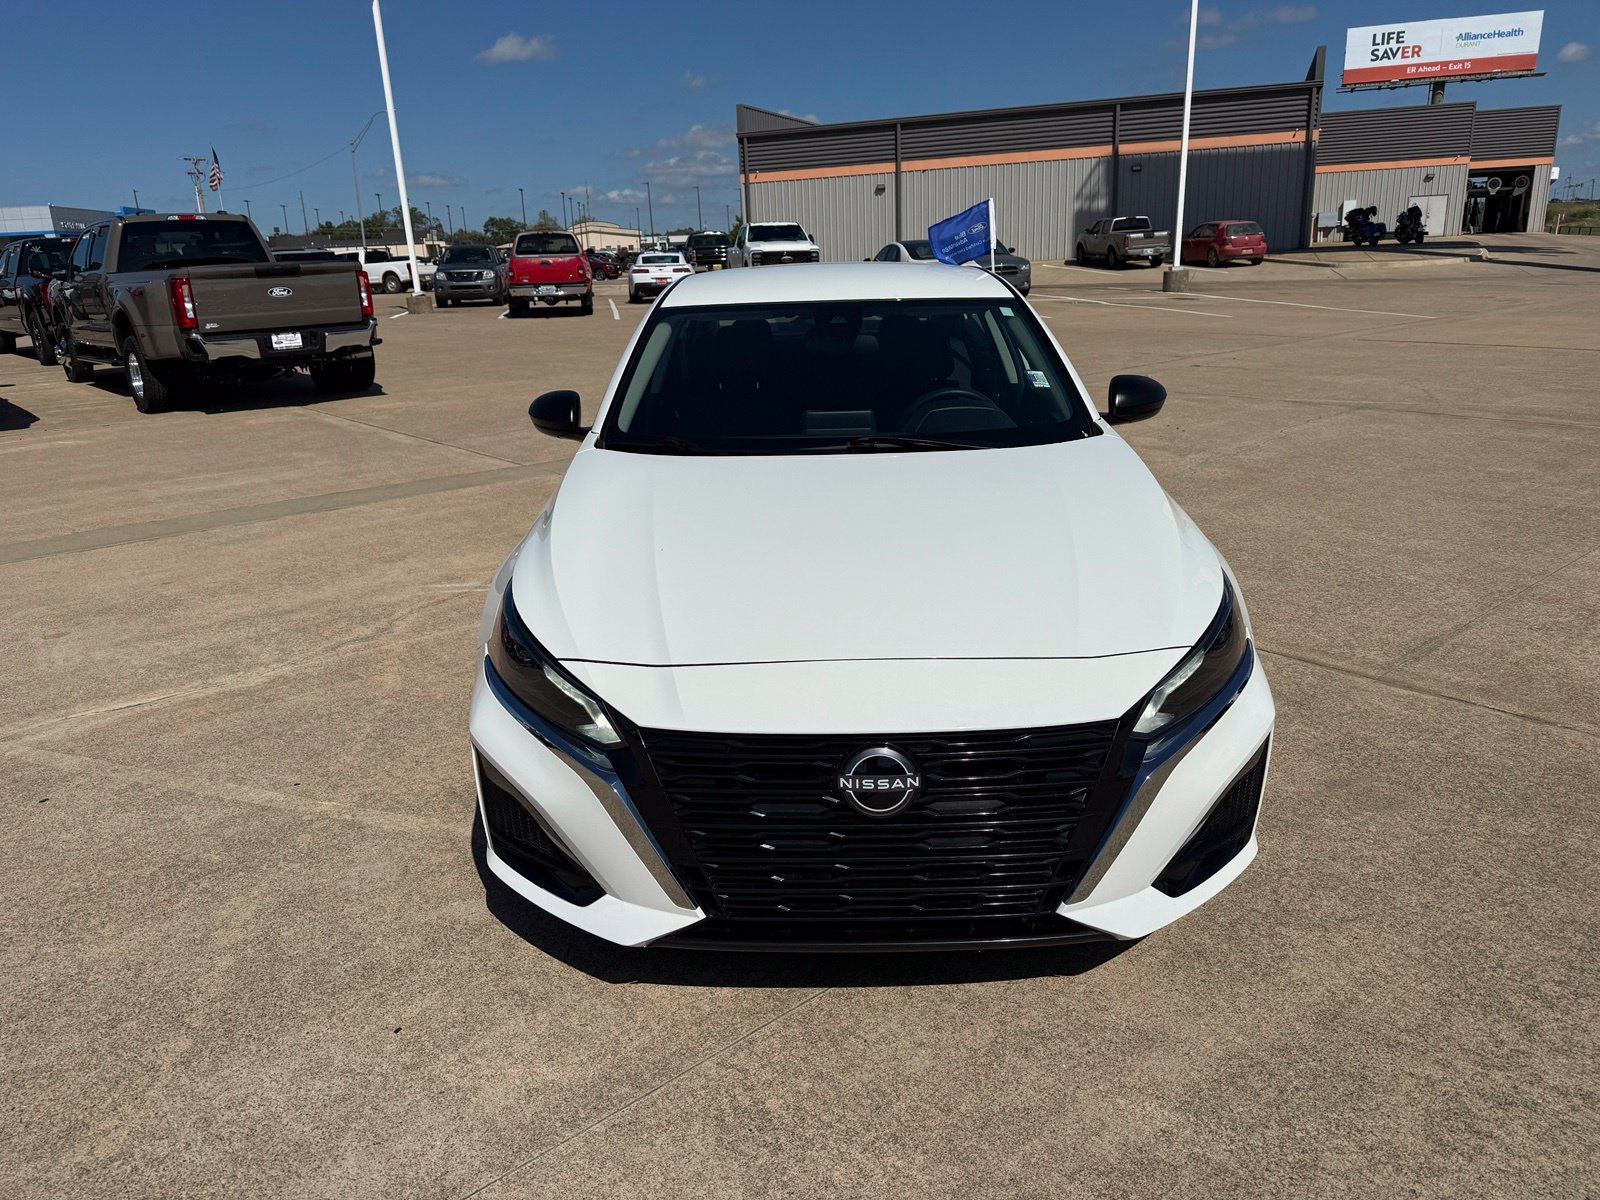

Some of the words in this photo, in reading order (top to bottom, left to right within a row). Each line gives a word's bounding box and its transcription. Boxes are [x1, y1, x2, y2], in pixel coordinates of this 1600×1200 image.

[1372, 31, 1405, 46] LIFE
[1456, 27, 1524, 41] AllianceHealth
[1370, 45, 1422, 61] SAVER
[1417, 64, 1440, 73] Ahead
[1448, 62, 1462, 70] Exit
[271, 287, 289, 296] Ford
[840, 777, 919, 789] NISSAN
